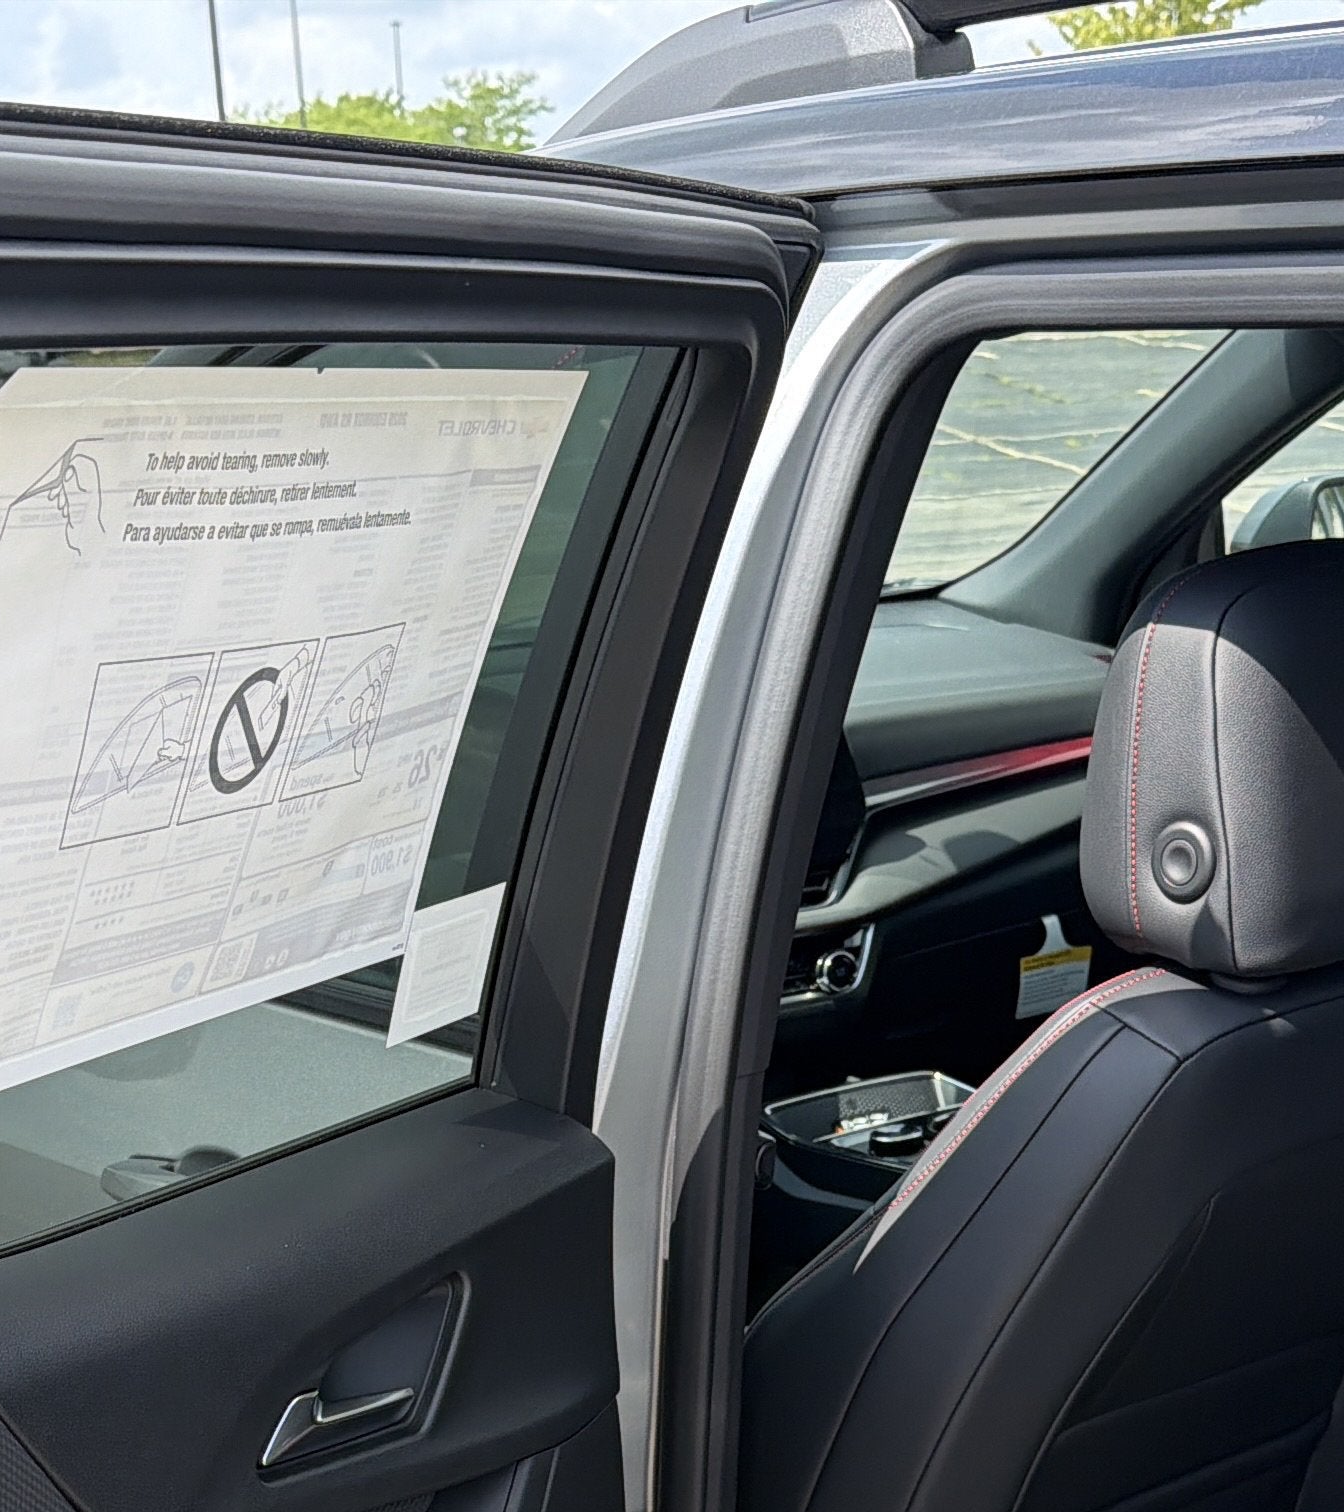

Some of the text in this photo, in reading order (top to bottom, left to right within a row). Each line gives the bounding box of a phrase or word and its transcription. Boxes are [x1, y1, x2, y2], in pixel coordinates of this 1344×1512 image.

[145, 447, 330, 474] To help avoid tearing, remove slowly.
[133, 480, 358, 507] Pour éviter toute déchirure, retirer lentement.
[122, 508, 412, 546] Para ayudarse a evitar que se rompa, remuévala lentamente.
